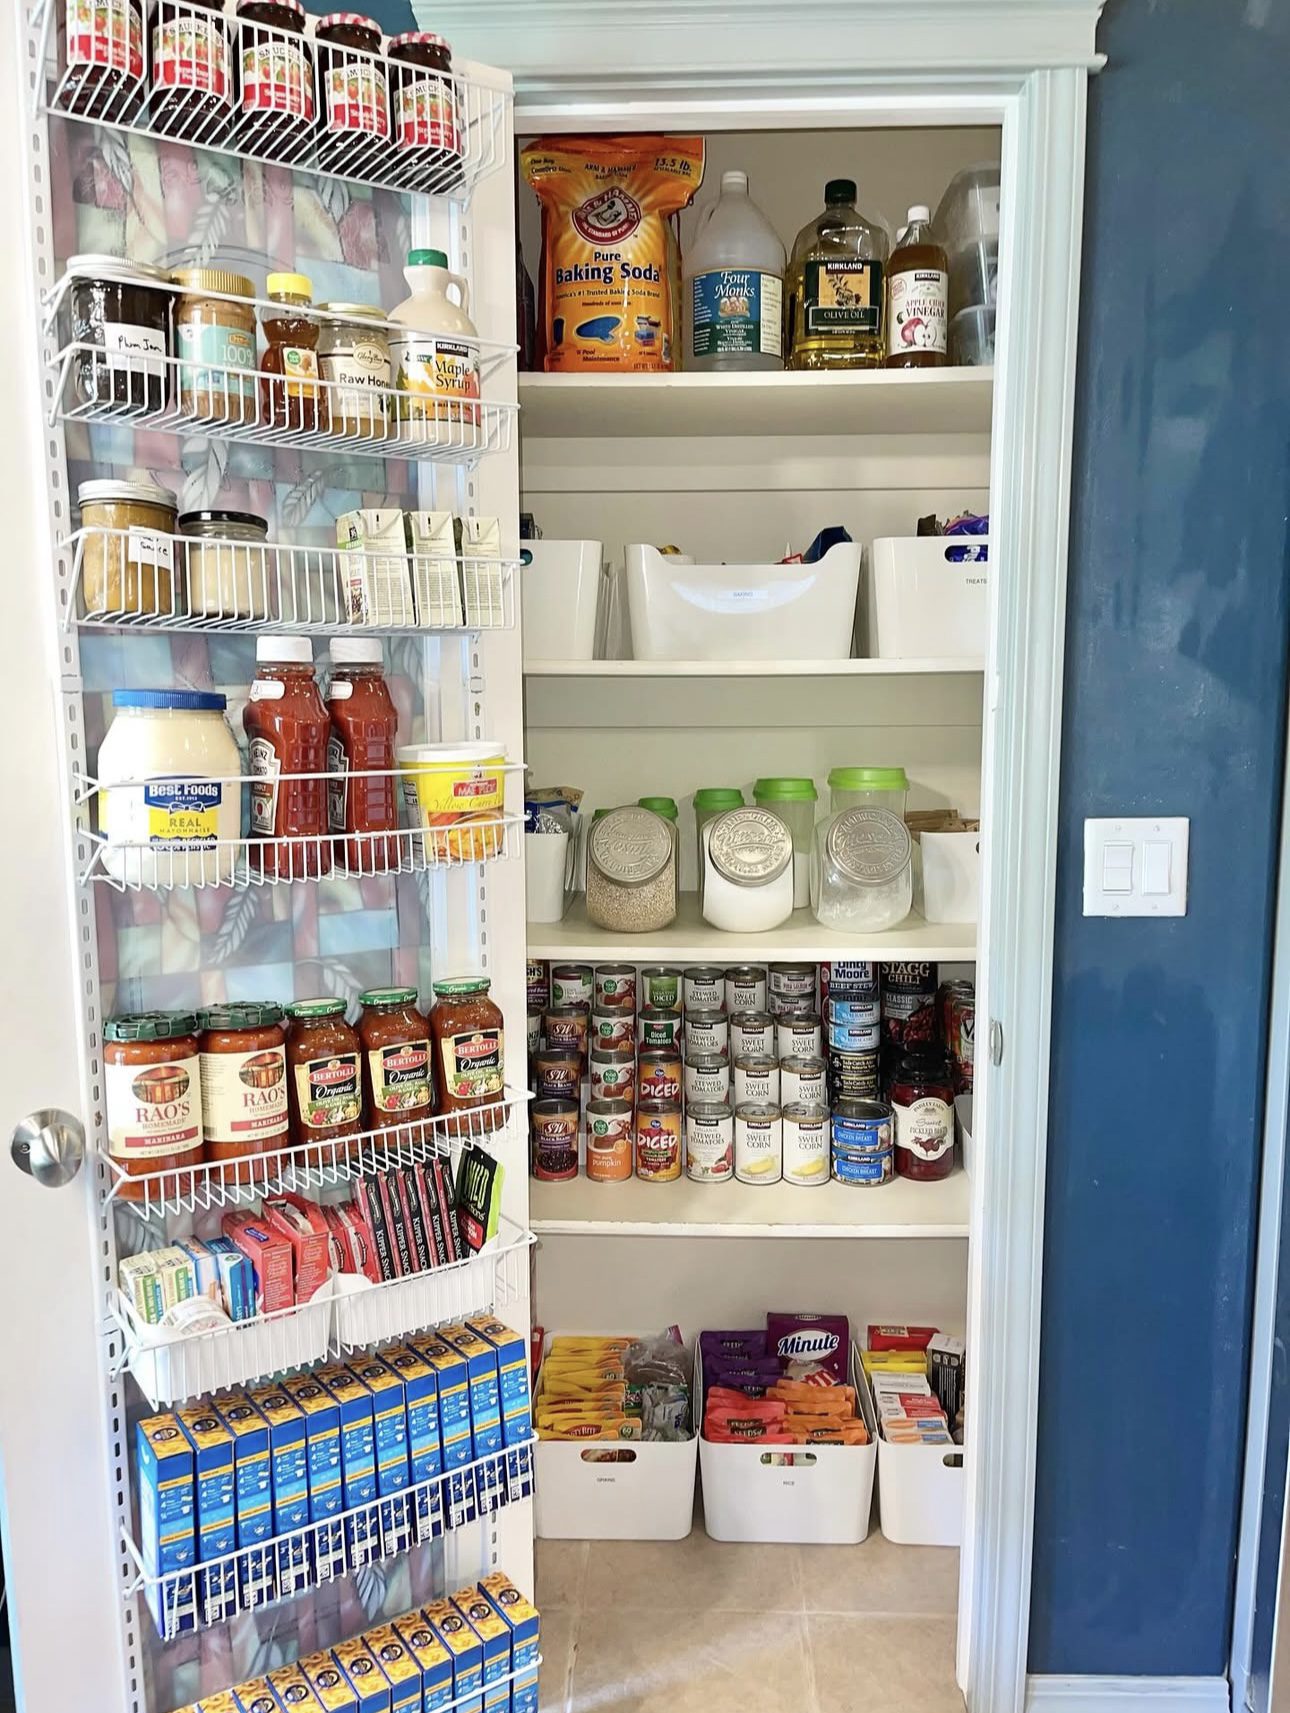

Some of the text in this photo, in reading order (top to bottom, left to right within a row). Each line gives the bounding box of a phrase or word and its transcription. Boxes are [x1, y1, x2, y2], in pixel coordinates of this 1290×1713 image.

[655, 157, 692, 171] 13.5 lb.
[594, 251, 621, 262] Pure
[827, 262, 863, 270] KIRKLAND
[556, 262, 660, 284] Baking Soda
[720, 271, 751, 287] Four
[586, 288, 608, 297] Trusted
[610, 288, 631, 296] Bakig
[631, 288, 646, 297] Soda
[714, 283, 755, 299] Monks
[906, 299, 926, 307] APPLE
[823, 310, 865, 319] OLIVE OIL
[906, 306, 945, 318] VINEGAR
[118, 334, 142, 350] Plum
[437, 342, 468, 353] KIRKLAND
[436, 359, 470, 378] Maple
[339, 373, 365, 384] Raw
[436, 373, 471, 394] Syrup
[149, 783, 218, 798] Best Foods
[169, 817, 202, 828] REAL
[834, 968, 870, 979] Moore
[881, 962, 930, 977] STAGG
[888, 974, 920, 984] CHILI
[689, 995, 720, 1003] TOMATOES
[886, 993, 913, 1004] CLASSIC
[646, 1037, 672, 1045] Tomatoes
[688, 1040, 719, 1048] TOMATOES
[742, 1038, 765, 1046] SWEET
[457, 1041, 497, 1055] BERTOLLI
[386, 1053, 426, 1068] BERTOLLI
[460, 1056, 496, 1072] Organic
[313, 1067, 354, 1082] BERTOLLI
[389, 1068, 425, 1085] Organic
[315, 1081, 354, 1100] Organic
[641, 1082, 680, 1097] DICED
[745, 1082, 770, 1090] SWEET
[243, 1086, 286, 1108] RAO'S
[800, 1092, 822, 1100] CORN
[136, 1101, 190, 1123] RAO'S
[144, 1132, 186, 1145] MARINARA
[637, 1134, 679, 1150] DICED
[746, 1134, 772, 1142] SWEET
[798, 1135, 823, 1143] SWEET
[746, 1141, 771, 1149] CORN
[799, 1142, 823, 1150] CORN
[592, 1158, 621, 1168] pumpkin
[433, 1214, 442, 1242] KIPPER
[449, 1209, 460, 1238] KIPPER
[396, 1222, 406, 1250] KIPPER
[413, 1216, 423, 1245] KIPPER
[376, 1229, 387, 1258] KIPPER
[778, 1332, 839, 1356] Minute
[582, 1426, 596, 1435] BITE
